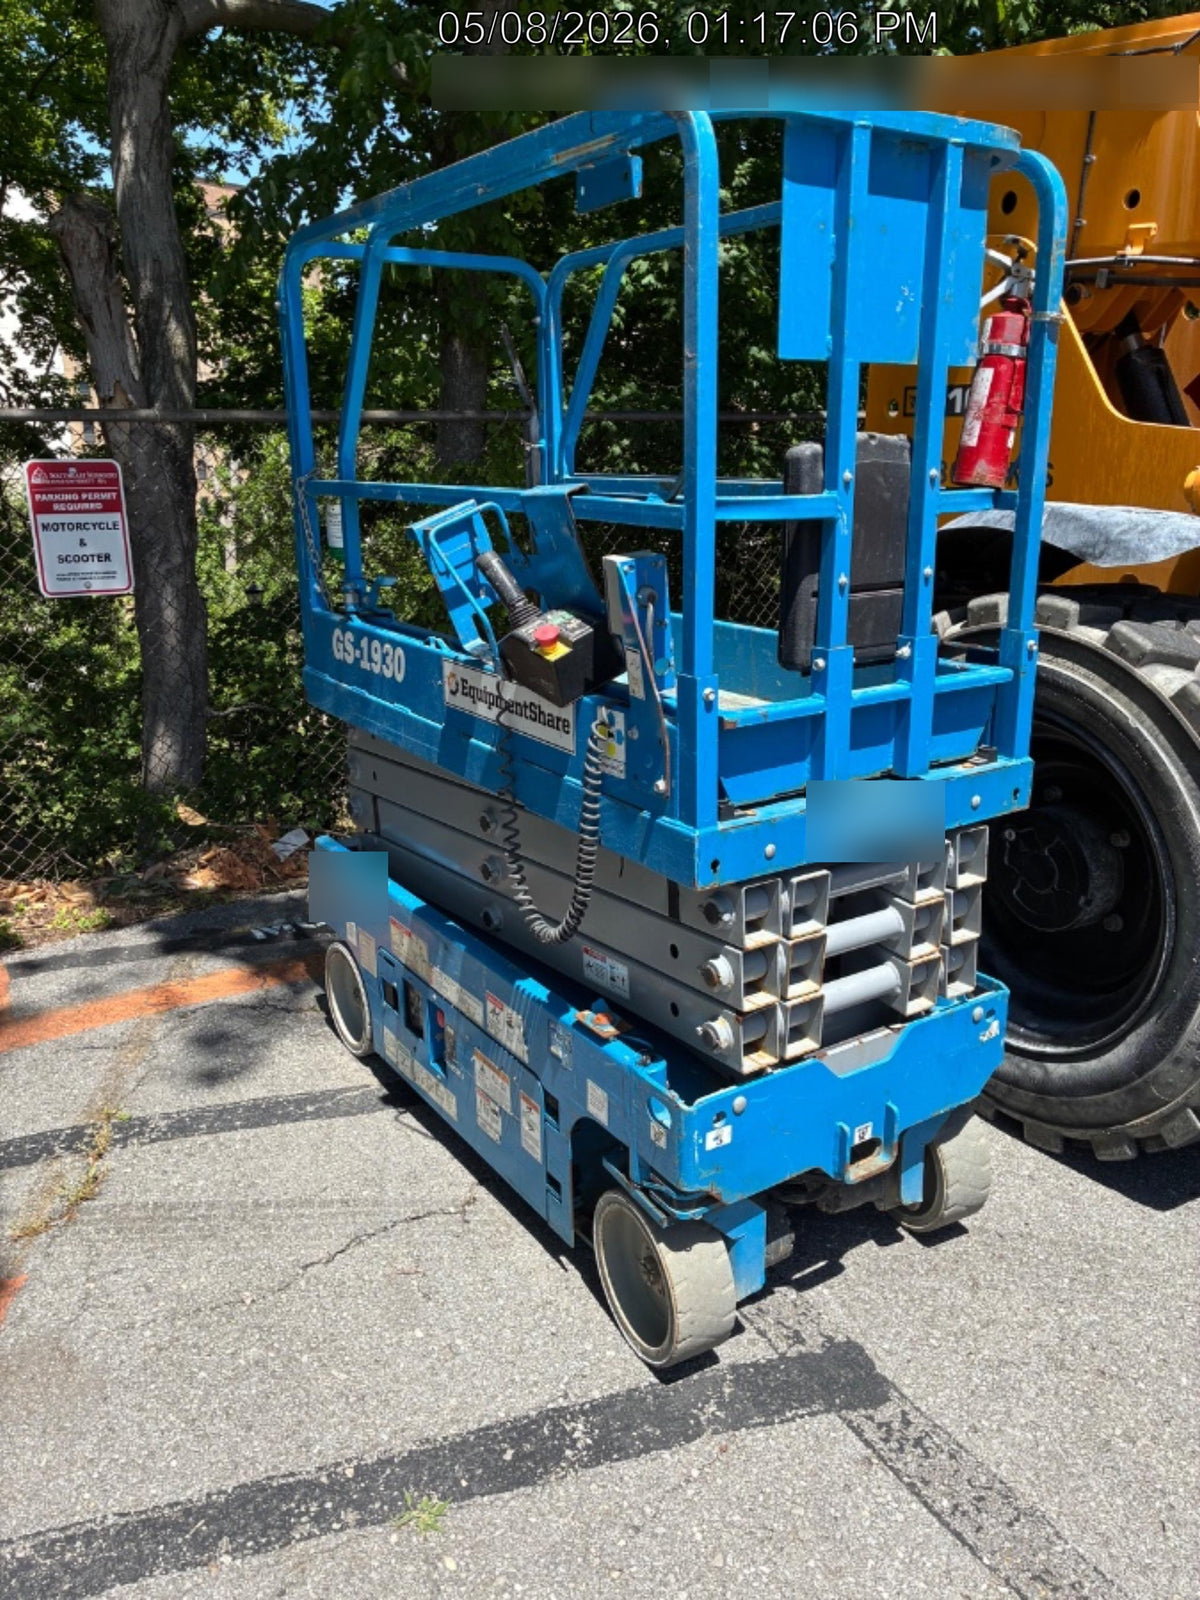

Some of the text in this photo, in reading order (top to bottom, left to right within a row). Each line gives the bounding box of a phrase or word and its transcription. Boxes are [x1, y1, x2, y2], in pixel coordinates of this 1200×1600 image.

[34, 492, 118, 502] PARKING PERMIT
[53, 502, 103, 511] REQUIRED
[41, 521, 120, 532] MOTORCYCLE
[79, 538, 87, 548] &
[57, 553, 112, 564] SCOOTER
[332, 628, 406, 683] GS-1930
[460, 677, 571, 735] EquipmentShare
